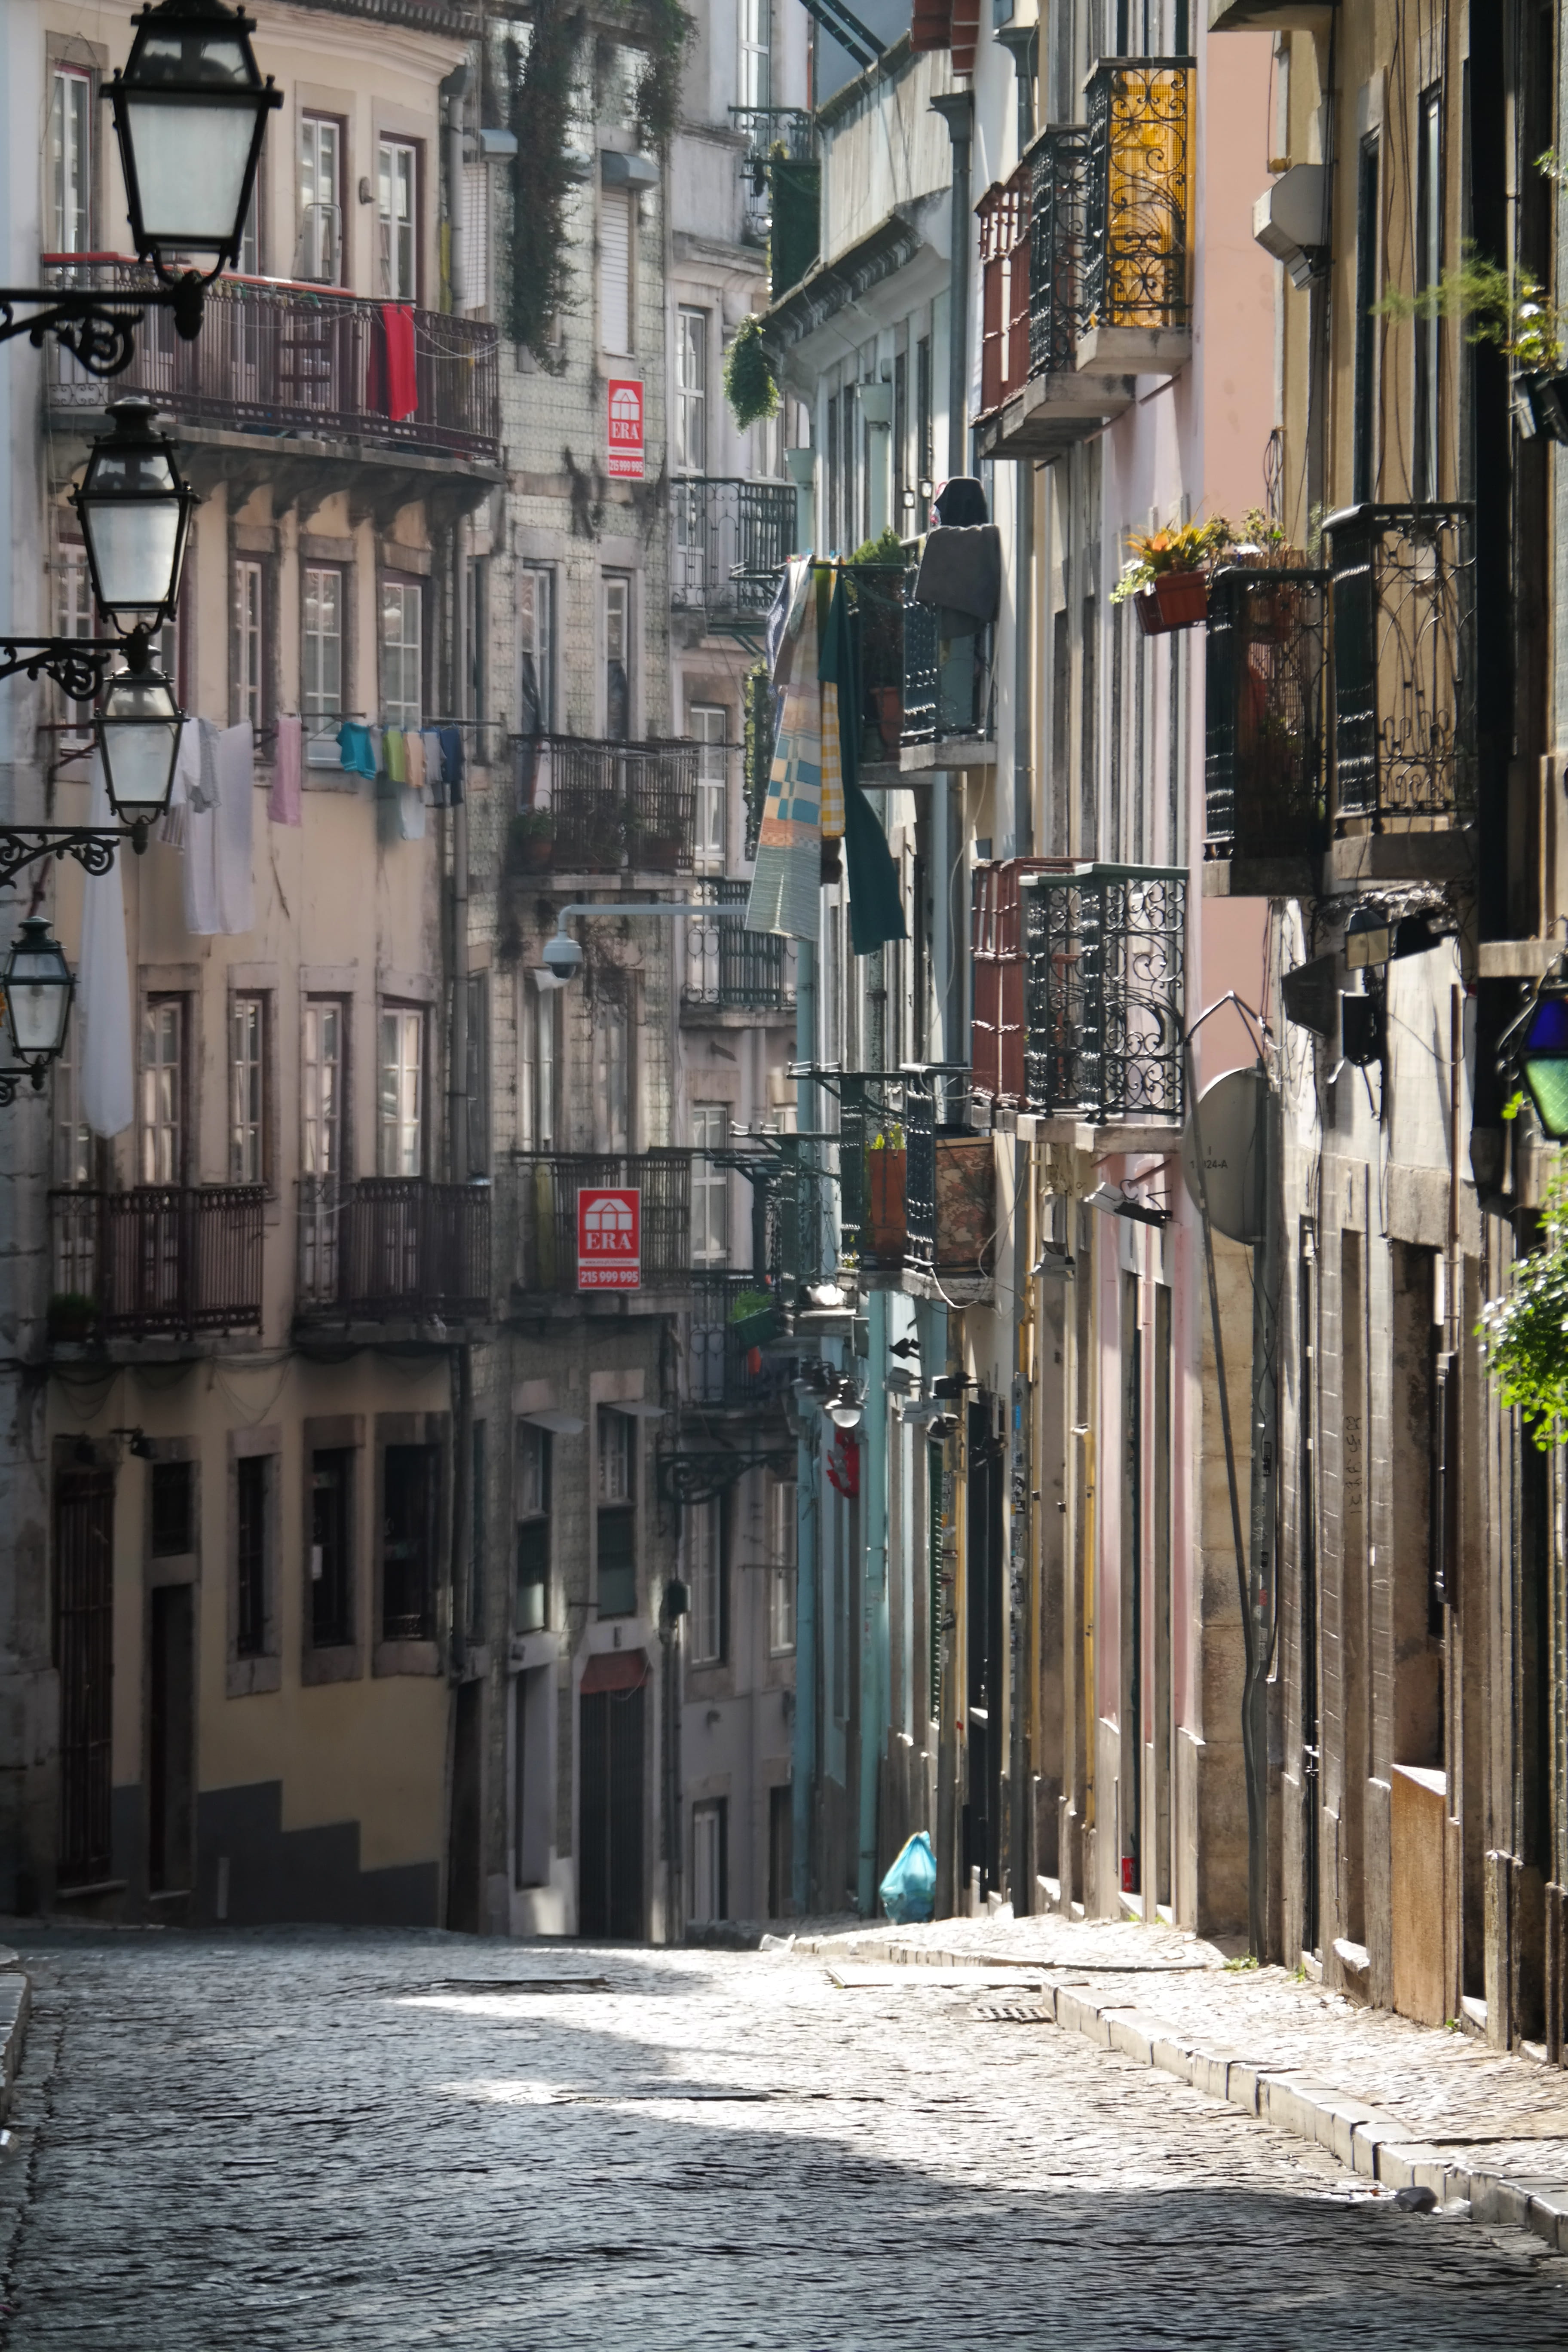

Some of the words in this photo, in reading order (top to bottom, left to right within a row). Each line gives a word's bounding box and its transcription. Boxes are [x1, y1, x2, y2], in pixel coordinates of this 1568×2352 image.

[612, 422, 640, 439] ERA
[620, 460, 631, 472] 999
[632, 461, 643, 473] 995
[586, 1233, 632, 1249] ERA
[581, 1272, 597, 1283] 215
[600, 1272, 618, 1283] 999
[620, 1272, 639, 1283] 995
